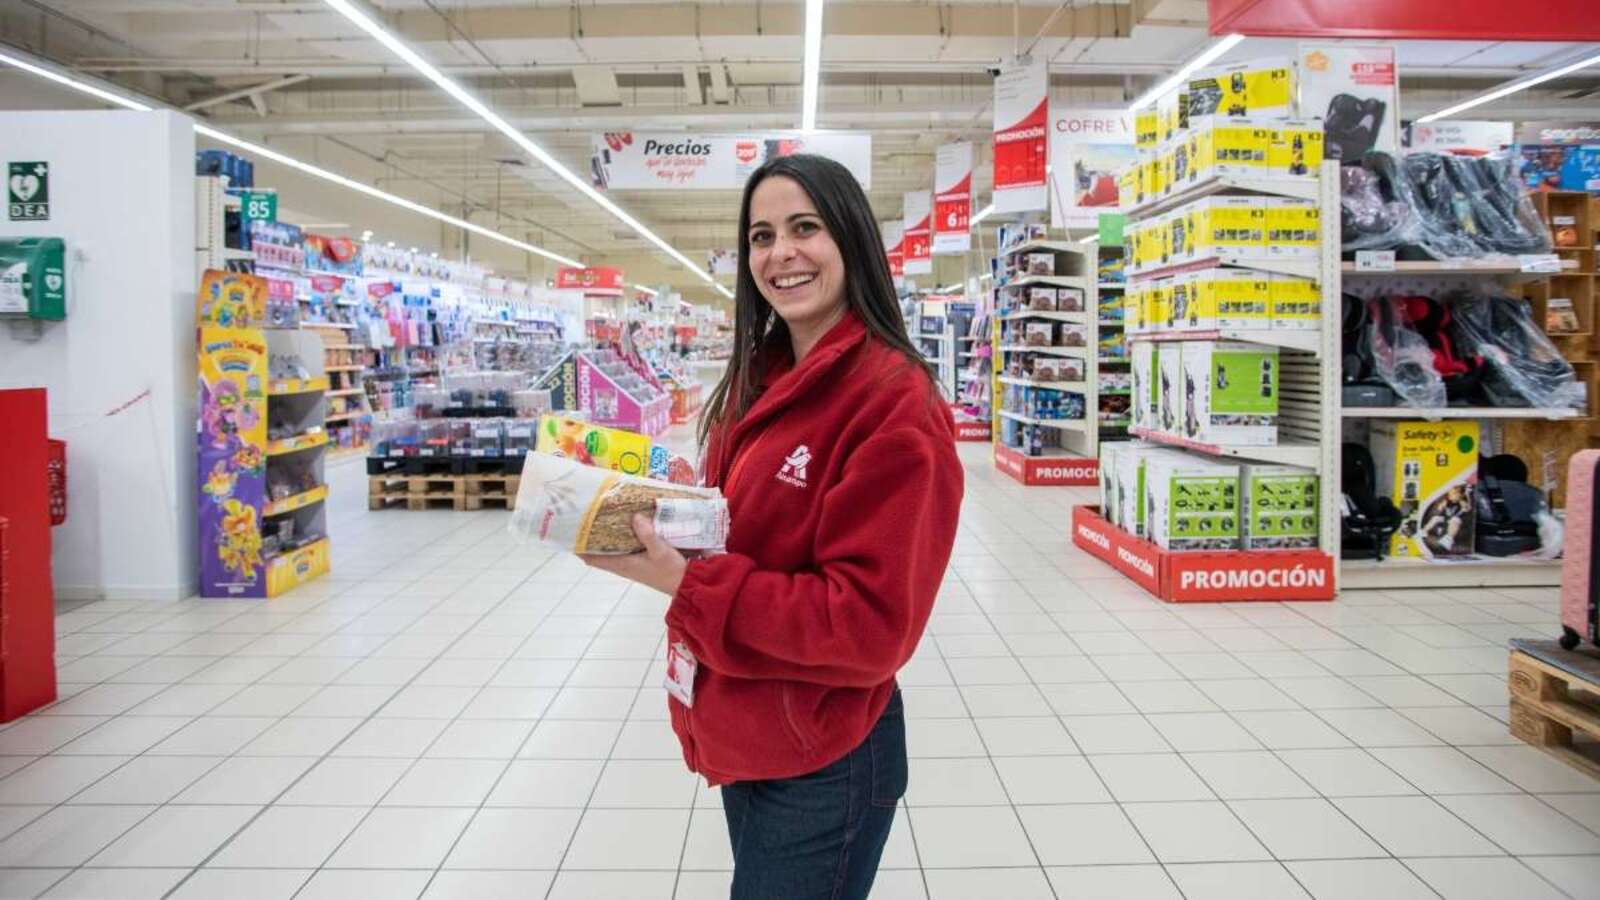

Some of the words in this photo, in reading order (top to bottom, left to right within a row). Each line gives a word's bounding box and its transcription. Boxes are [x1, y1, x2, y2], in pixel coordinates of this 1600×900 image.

[1056, 119, 1116, 133] COFRE
[644, 139, 712, 155] Precios
[11, 205, 48, 217] DEA
[248, 201, 270, 218] 85
[1036, 467, 1099, 479] PROMOCI
[1180, 564, 1325, 589] PROMOCIÓN
